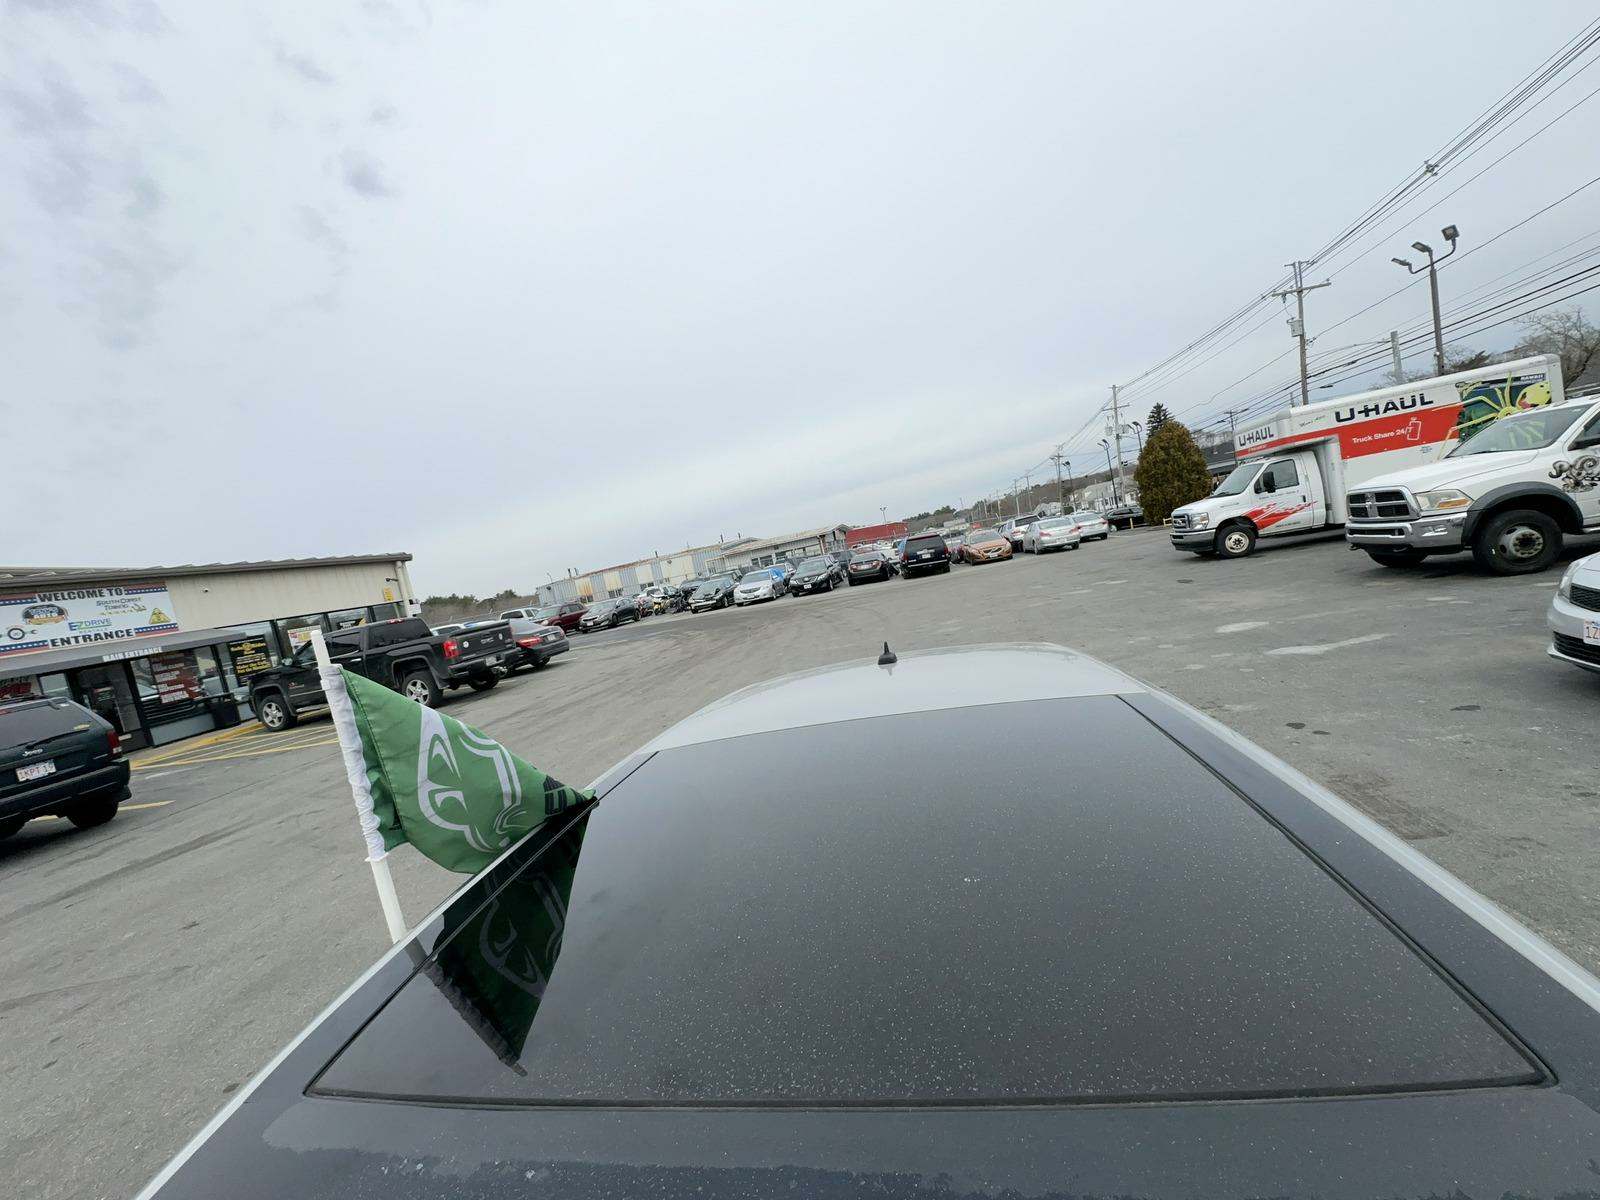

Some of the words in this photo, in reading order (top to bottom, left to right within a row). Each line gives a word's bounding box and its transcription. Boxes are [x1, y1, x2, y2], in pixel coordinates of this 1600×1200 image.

[1335, 393, 1434, 423] U-HAUL
[1238, 426, 1275, 447] U-HAUL
[1352, 434, 1373, 444] Truck
[1374, 431, 1395, 440] Share
[1396, 426, 1414, 436] 24/7
[37, 588, 105, 603] WELCOME
[84, 617, 112, 627] DRIVE
[50, 628, 134, 648] ENTRANCE
[1585, 626, 1600, 640] 1Z
[102, 653, 124, 663] MAIN
[125, 647, 162, 659] ENTRANCE
